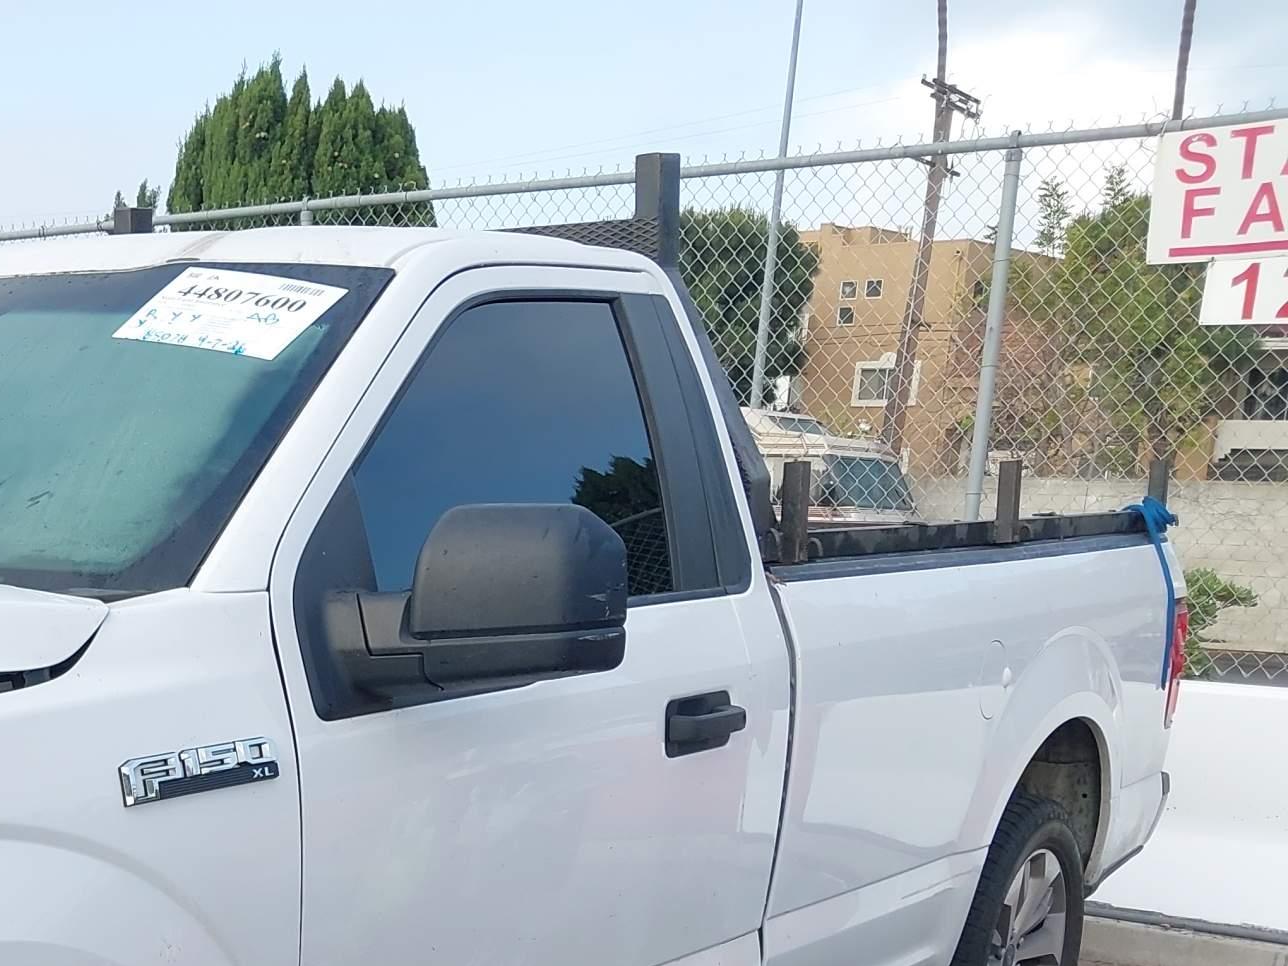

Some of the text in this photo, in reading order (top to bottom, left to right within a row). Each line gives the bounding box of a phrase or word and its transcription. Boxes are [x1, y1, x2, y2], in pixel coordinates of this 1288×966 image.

[1175, 125, 1288, 184] ST
[178, 284, 308, 313] 44807600
[252, 766, 275, 779] XL
